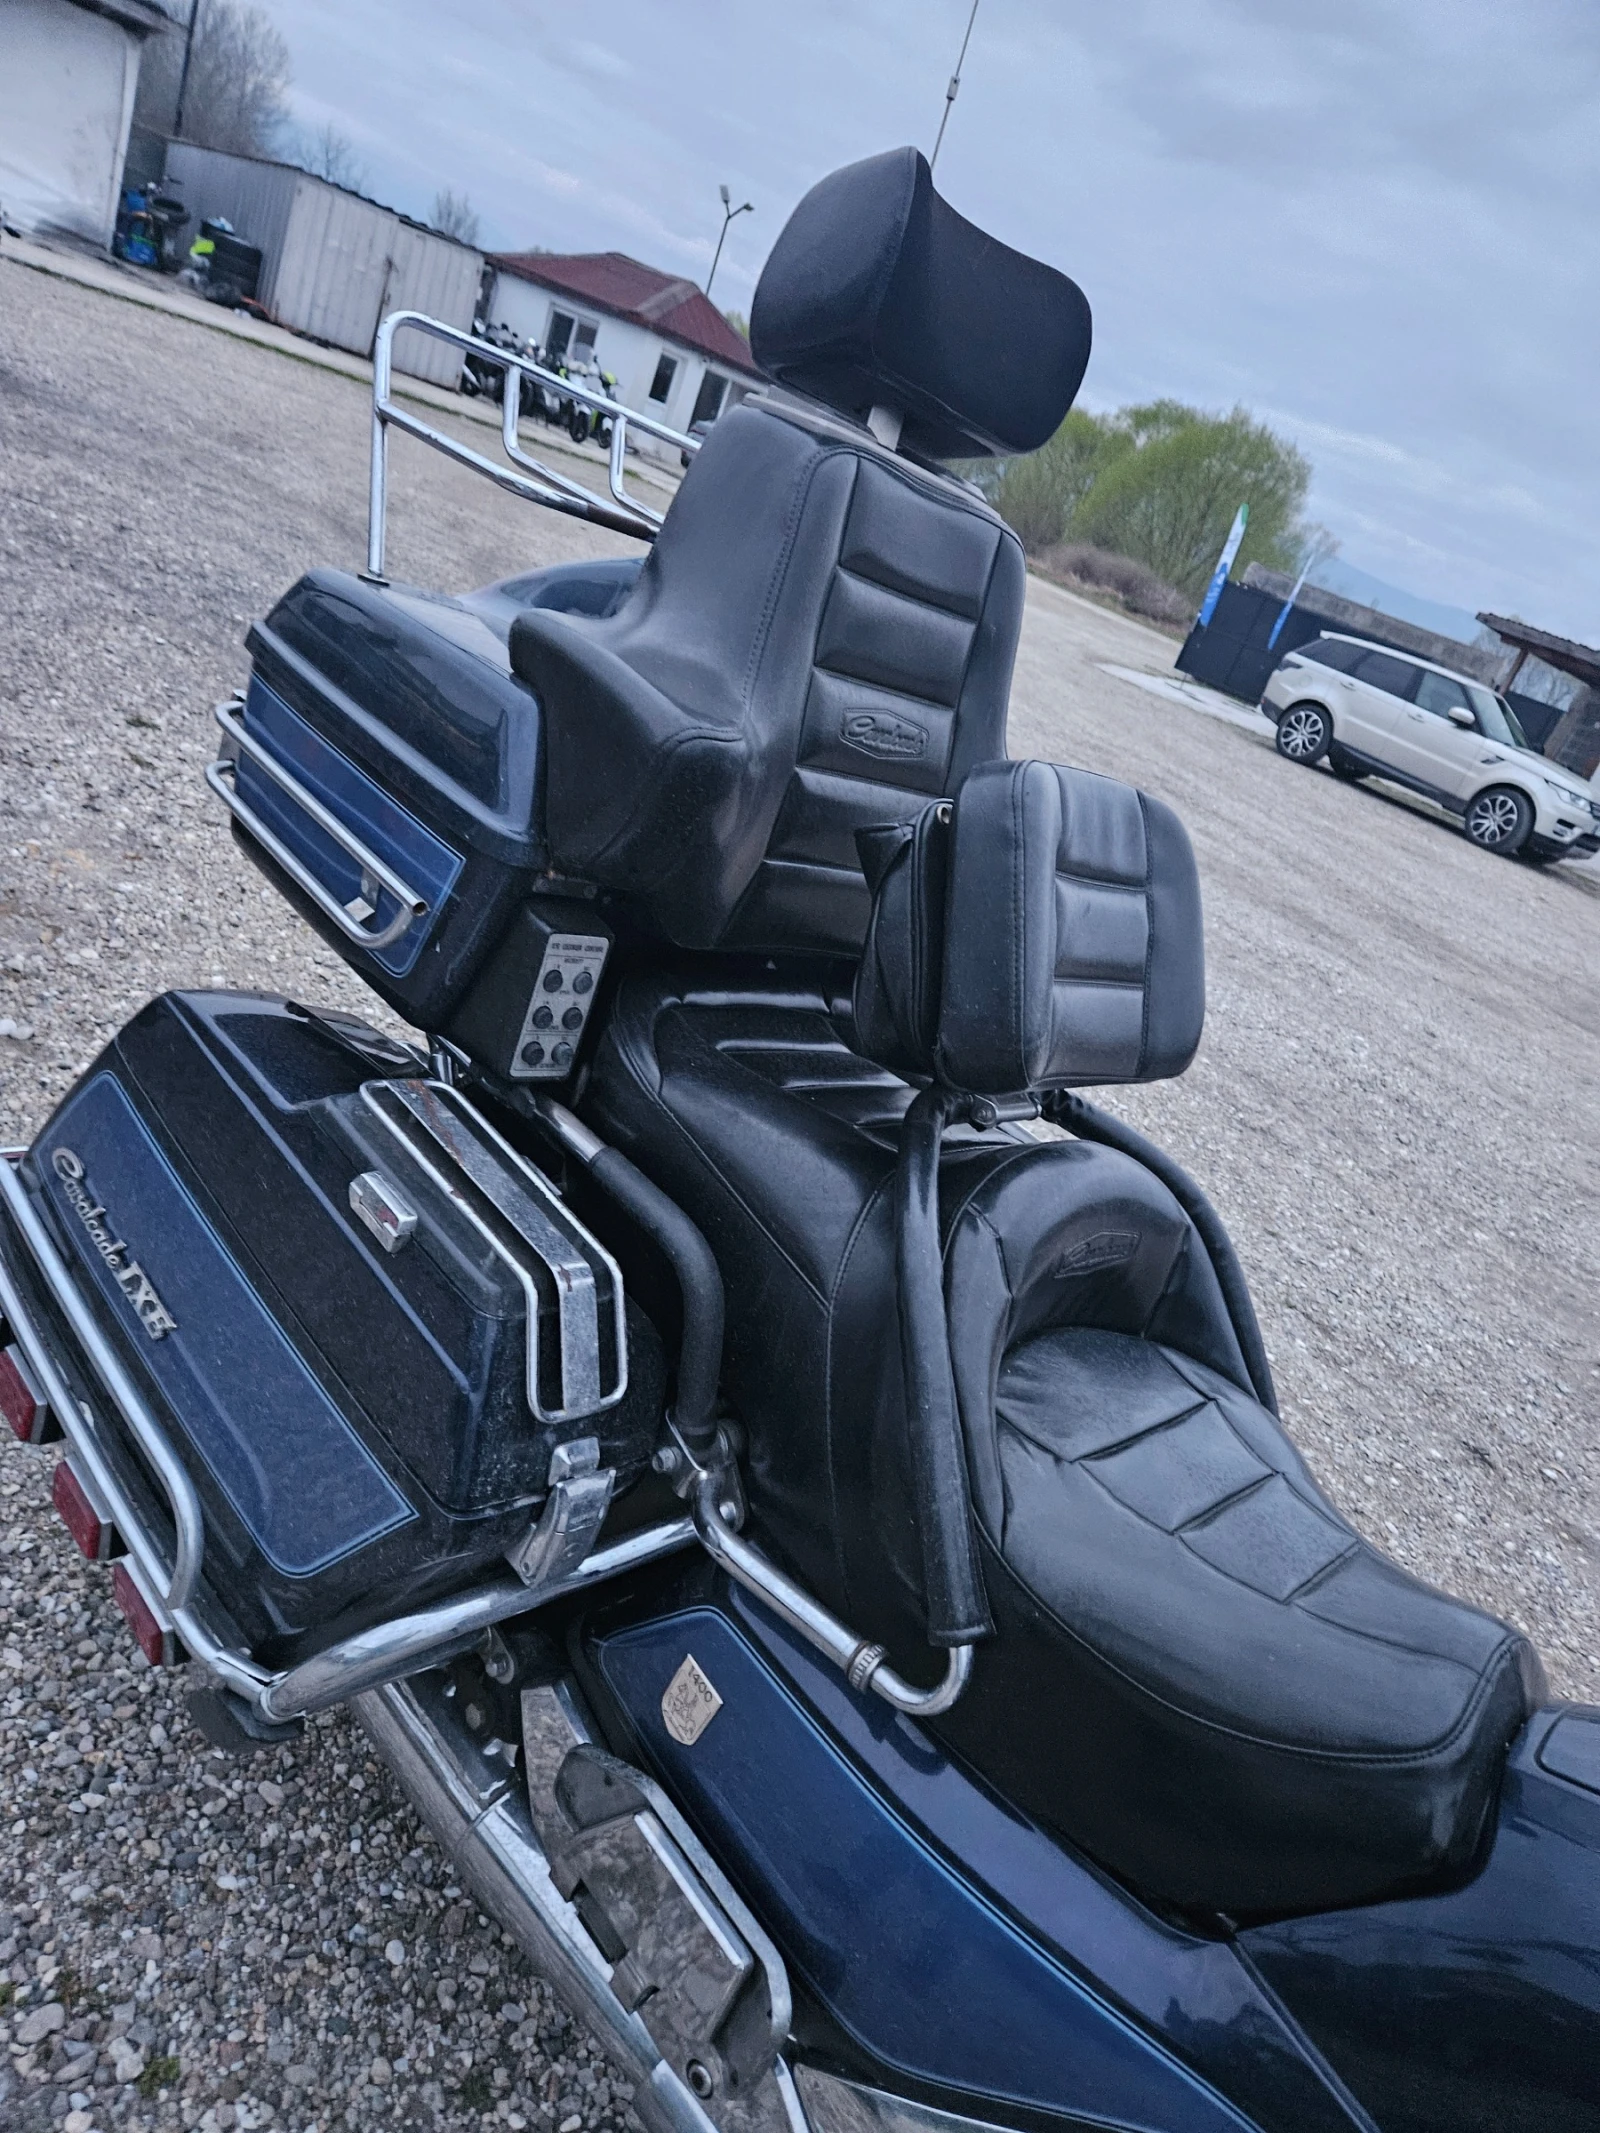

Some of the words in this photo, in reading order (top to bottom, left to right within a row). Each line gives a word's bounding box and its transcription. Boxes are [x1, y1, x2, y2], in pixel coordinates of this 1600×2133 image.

[52, 1147, 127, 1270] Cavalcade
[112, 1261, 177, 1340] LXE
[688, 1665, 713, 1703] 1400
